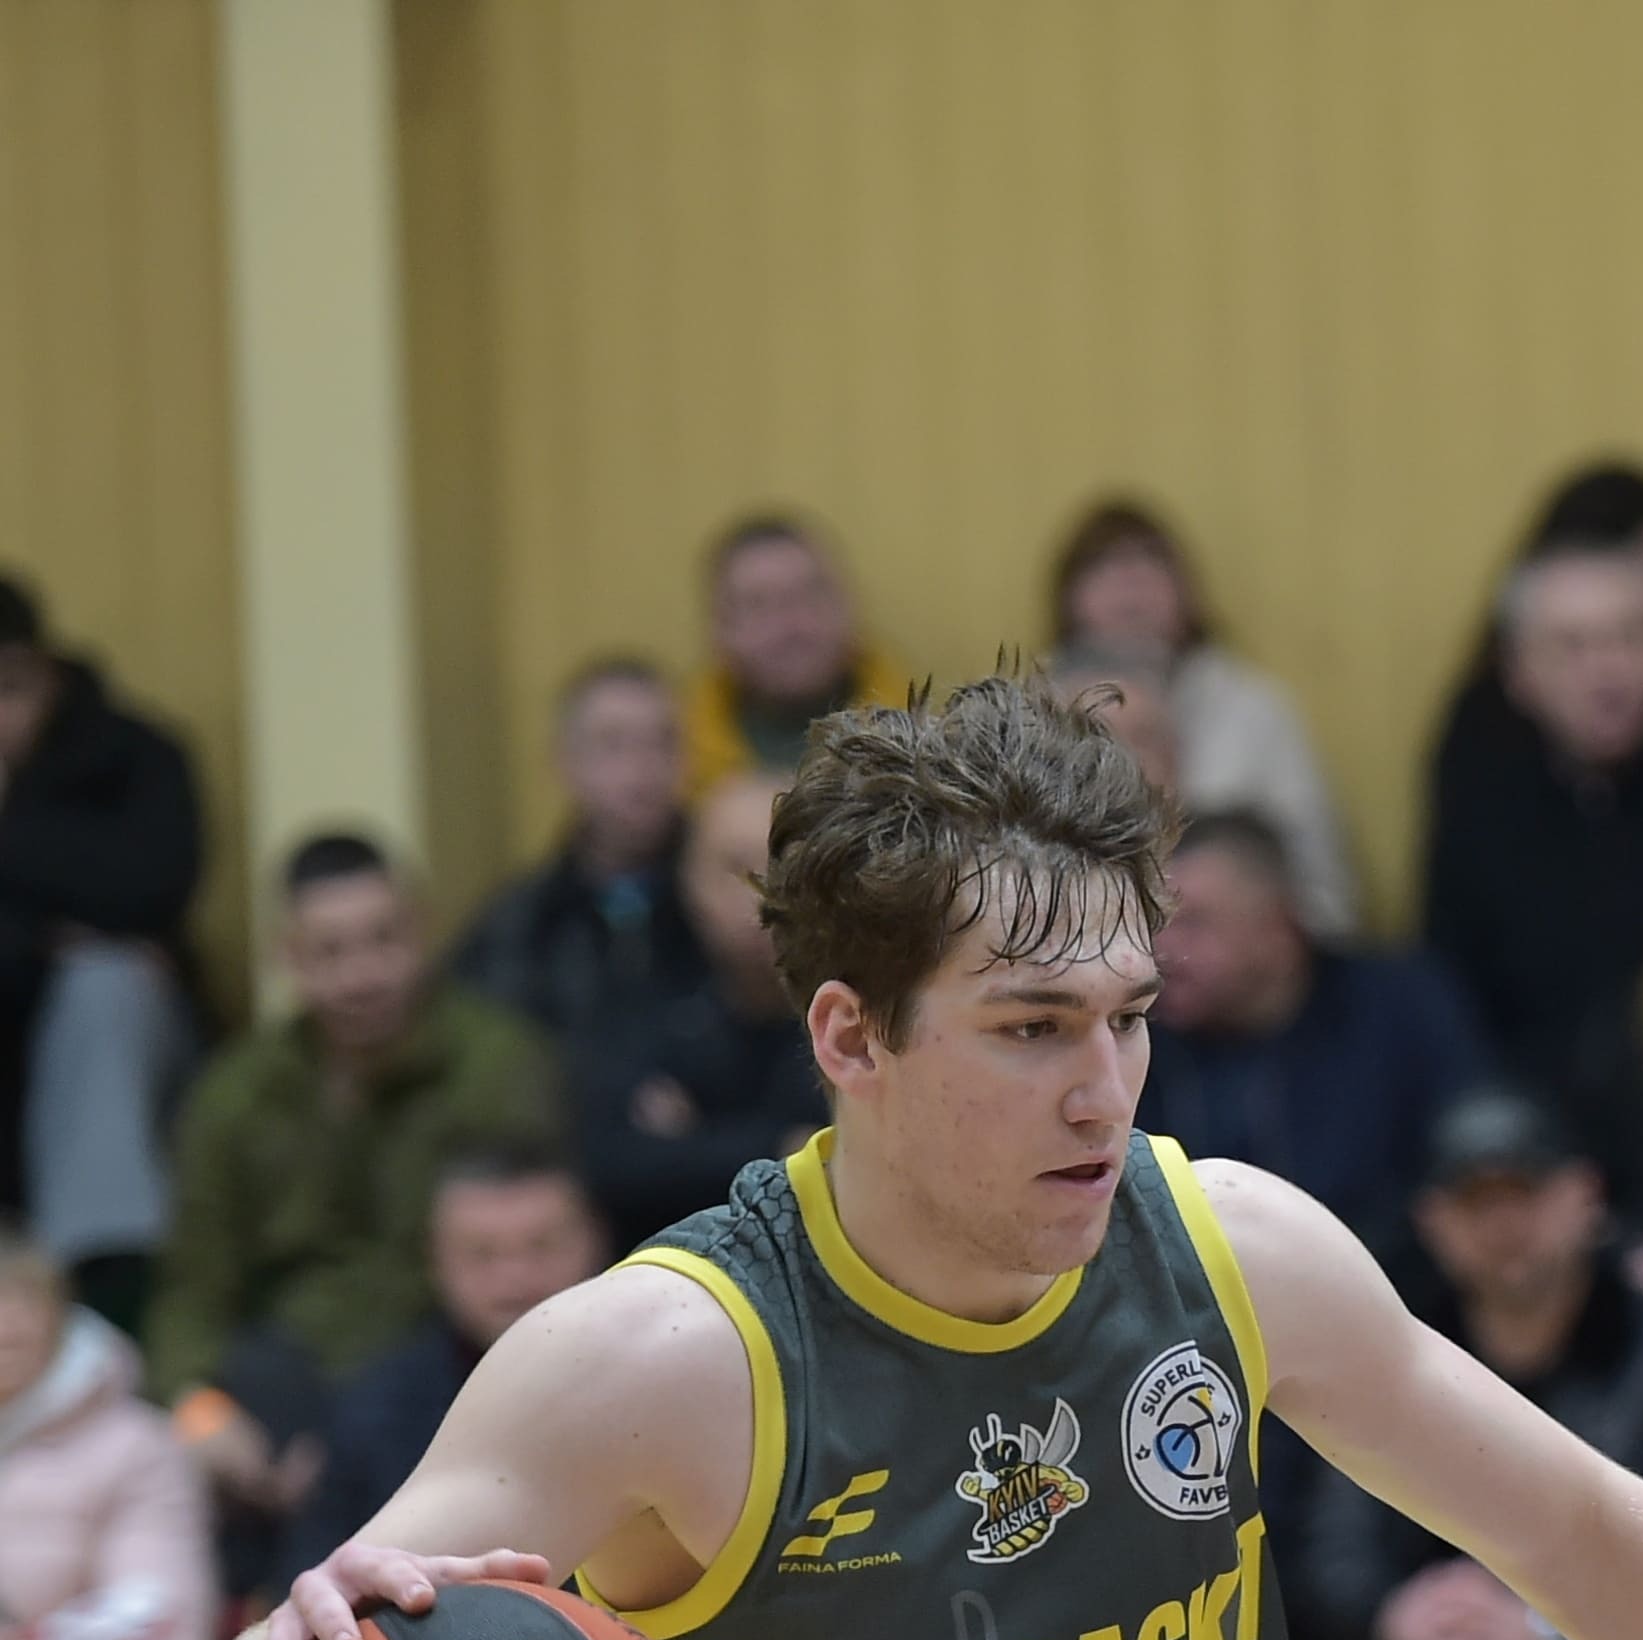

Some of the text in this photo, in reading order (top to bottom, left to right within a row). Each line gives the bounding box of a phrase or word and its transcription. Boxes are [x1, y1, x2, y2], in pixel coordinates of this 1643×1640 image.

[986, 1462, 1041, 1523] KYIV
[986, 1494, 1051, 1546] BASKET
[777, 1551, 902, 1574] FAINA FORMA
